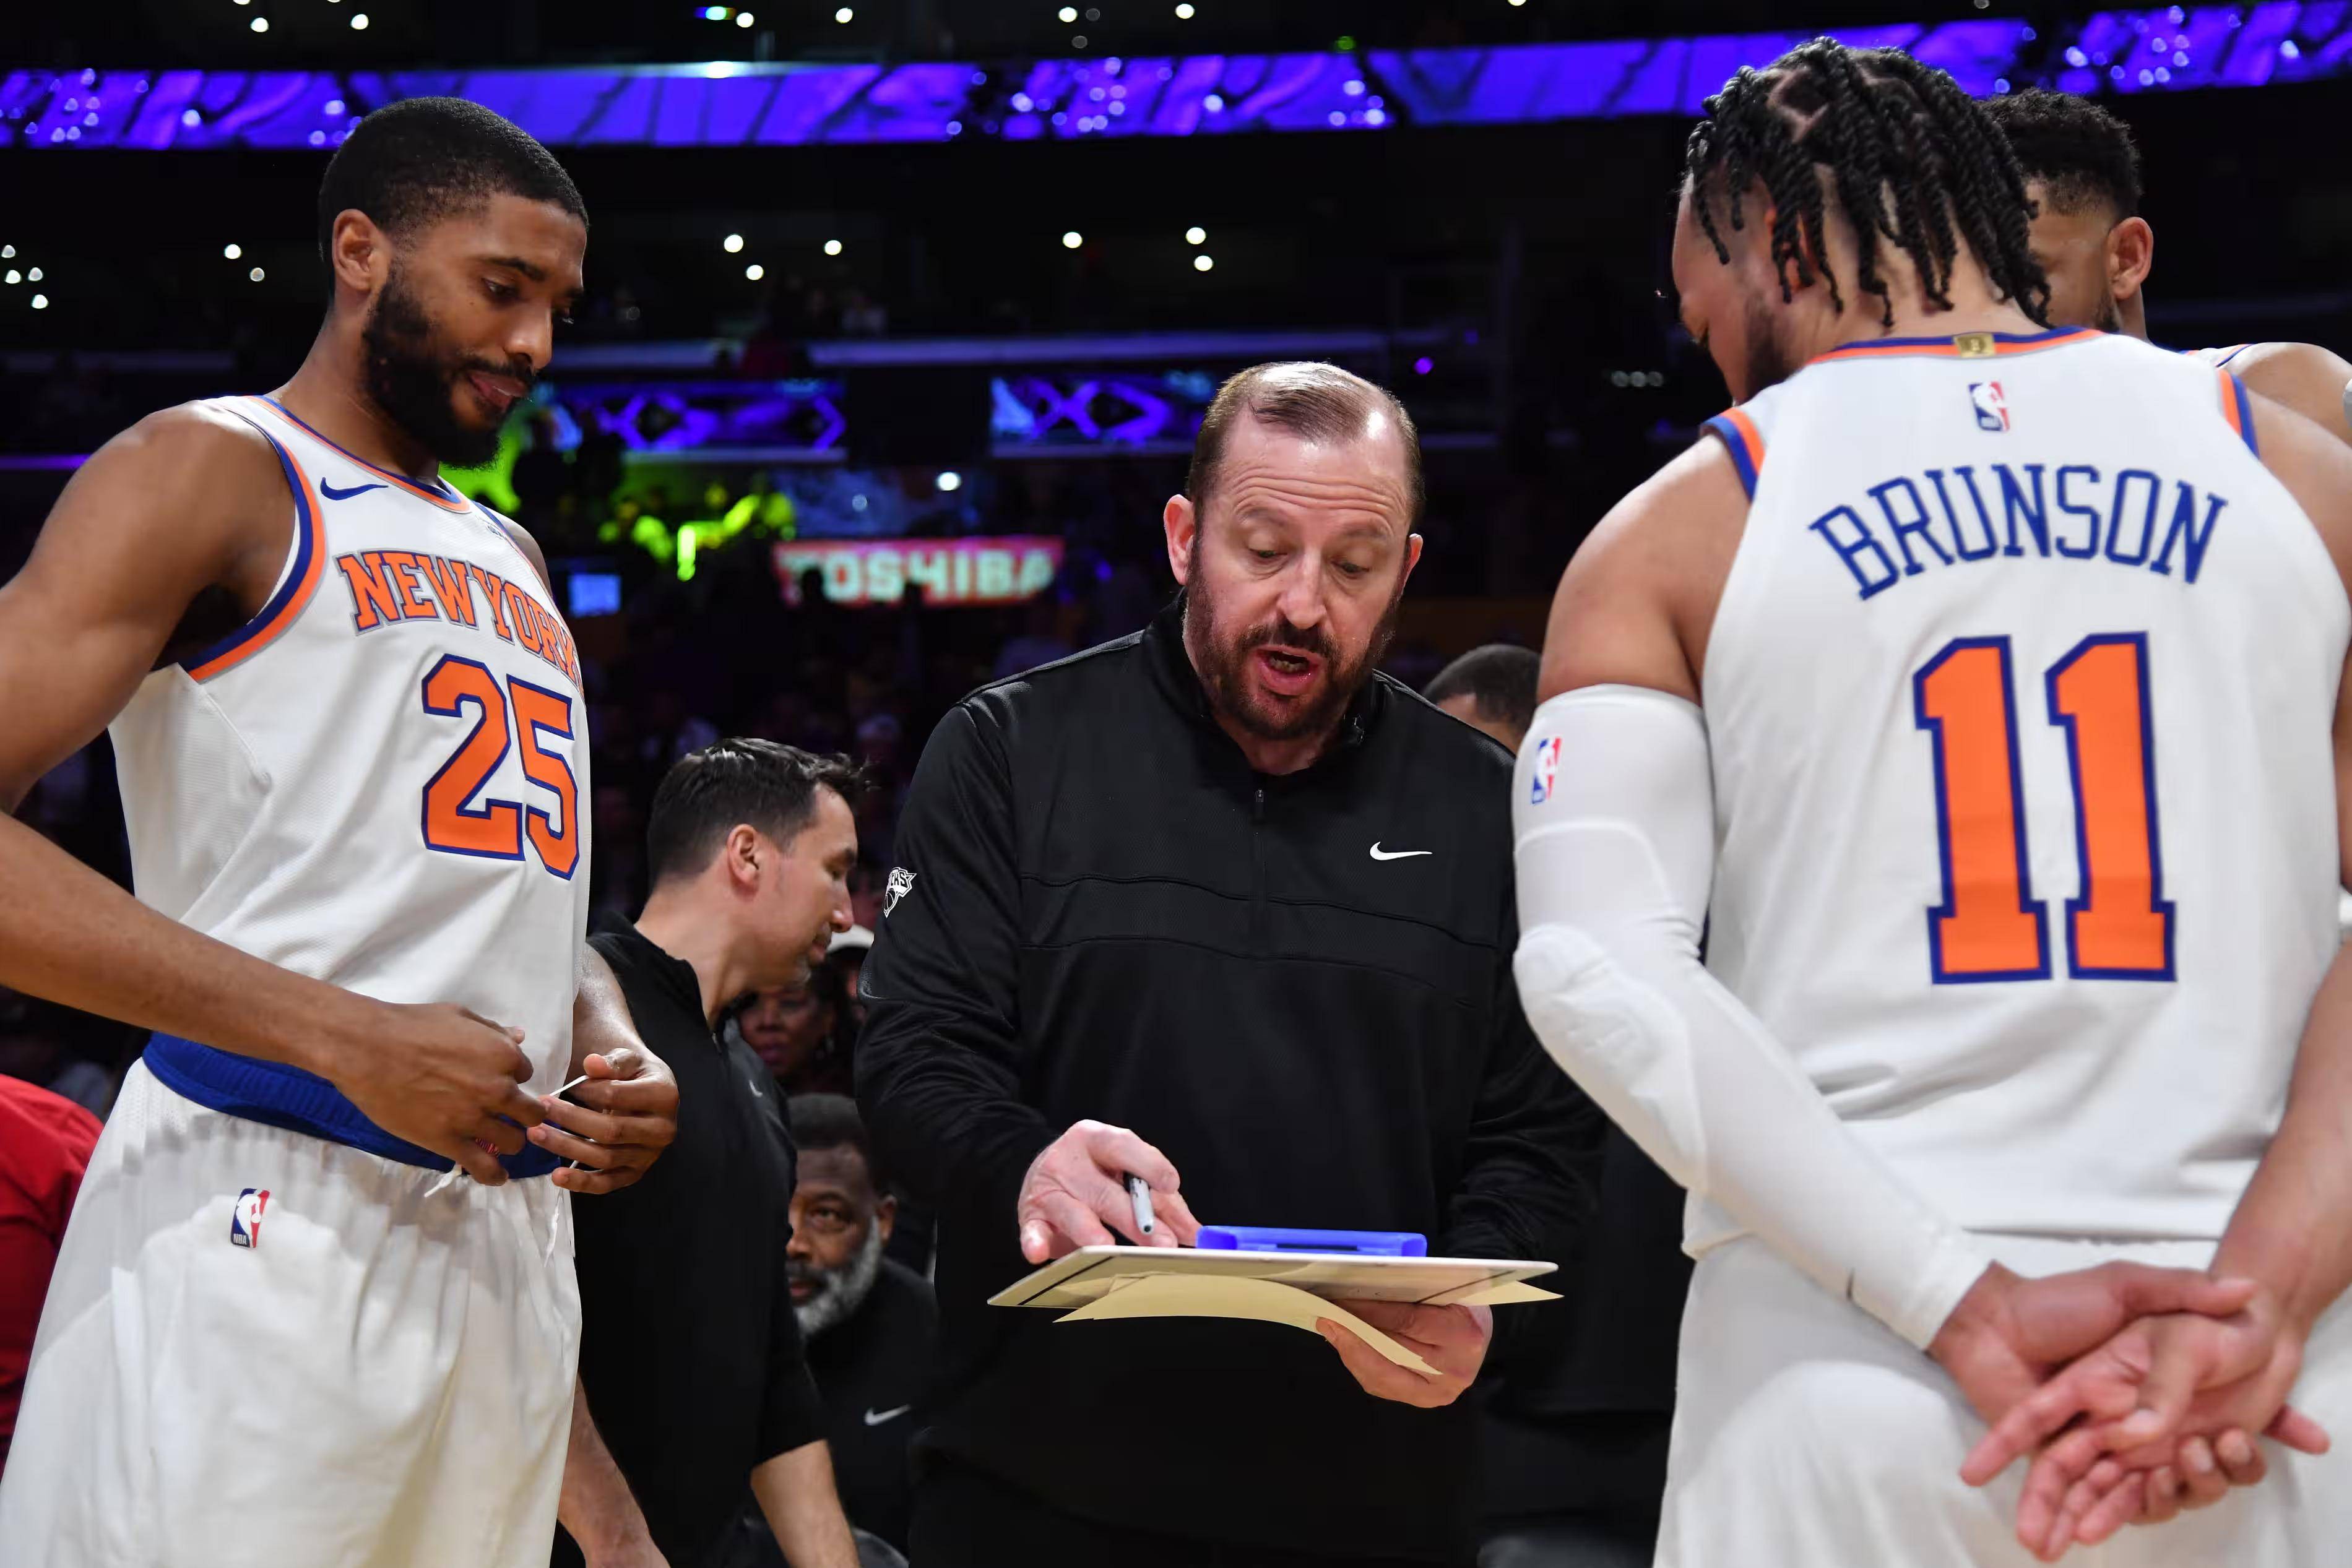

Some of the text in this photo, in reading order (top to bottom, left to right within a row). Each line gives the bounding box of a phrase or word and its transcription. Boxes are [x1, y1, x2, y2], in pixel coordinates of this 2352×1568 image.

[335, 548, 584, 694] NEW YORK
[1807, 463, 2229, 600] BRUNSON
[421, 653, 579, 881] 25
[1913, 631, 2177, 984] 11
